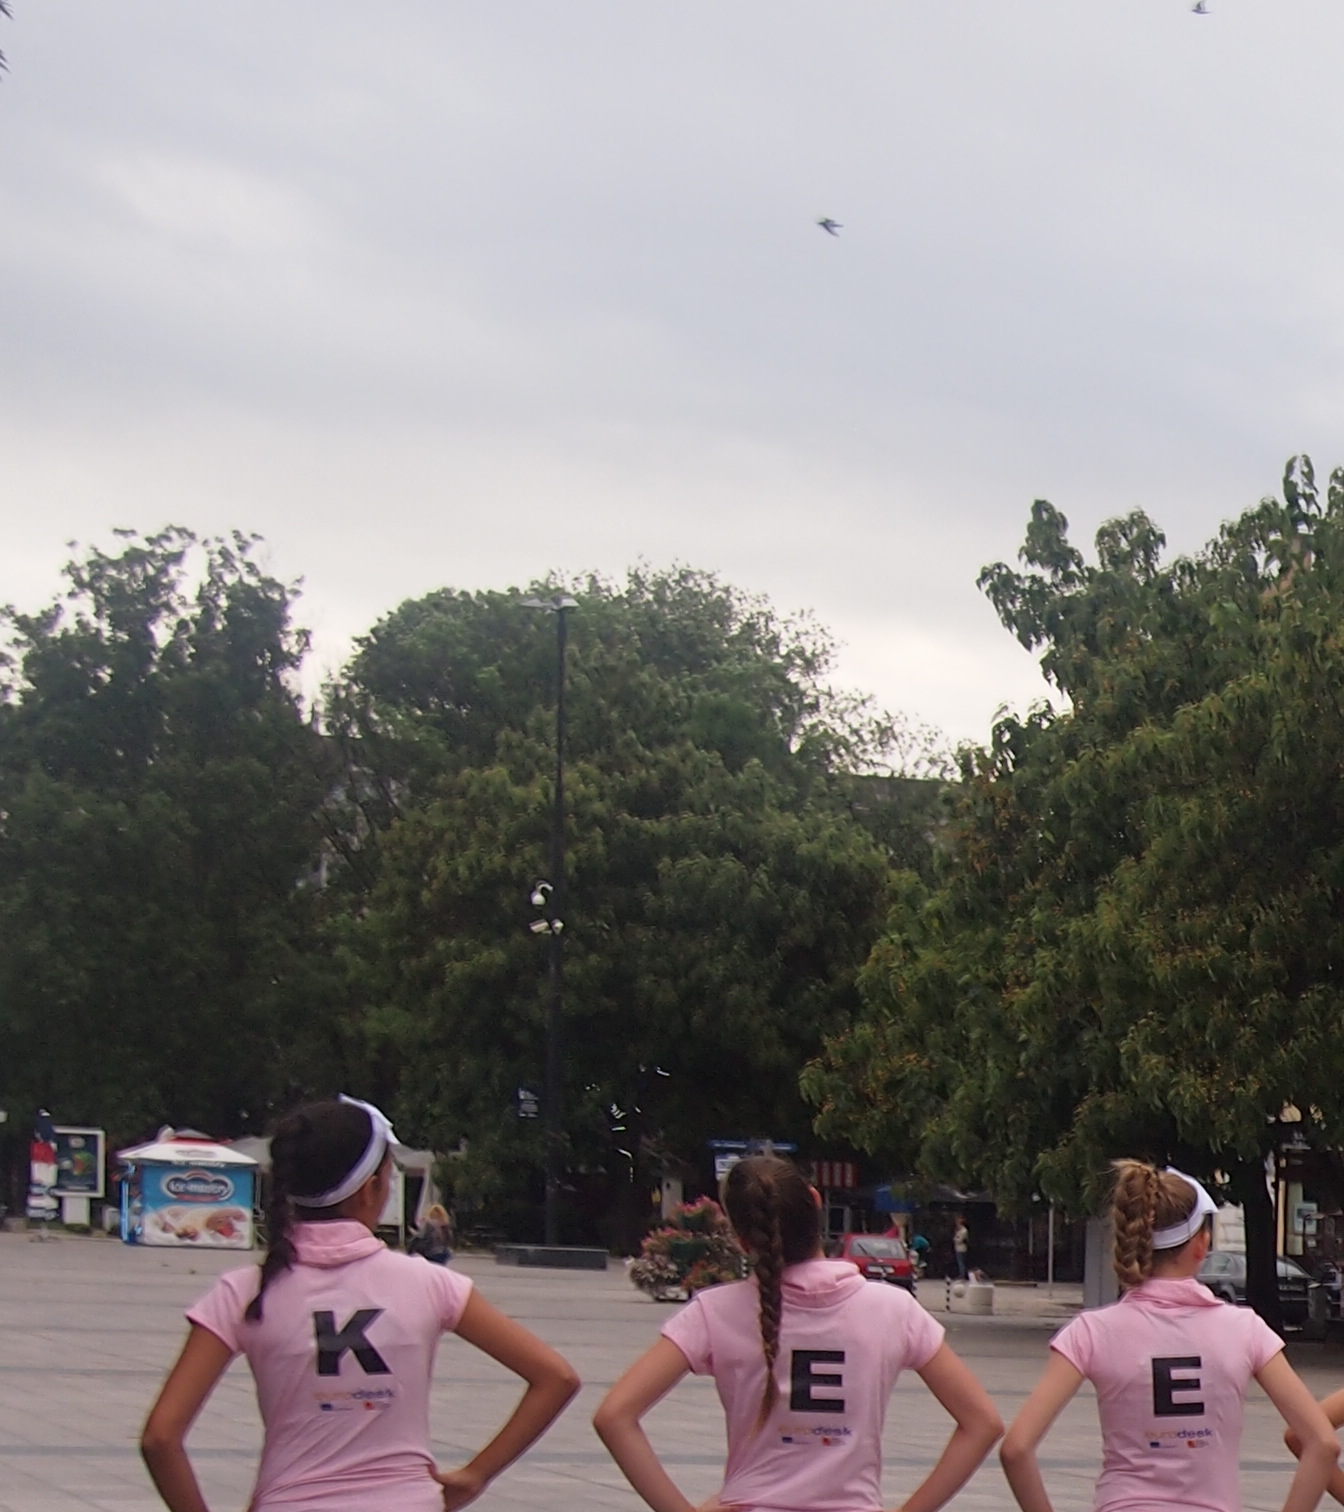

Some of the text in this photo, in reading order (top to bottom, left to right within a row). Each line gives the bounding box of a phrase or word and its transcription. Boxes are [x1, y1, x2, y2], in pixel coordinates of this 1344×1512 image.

[313, 1308, 393, 1376] K
[790, 1349, 845, 1413] E
[1152, 1356, 1205, 1417] E
